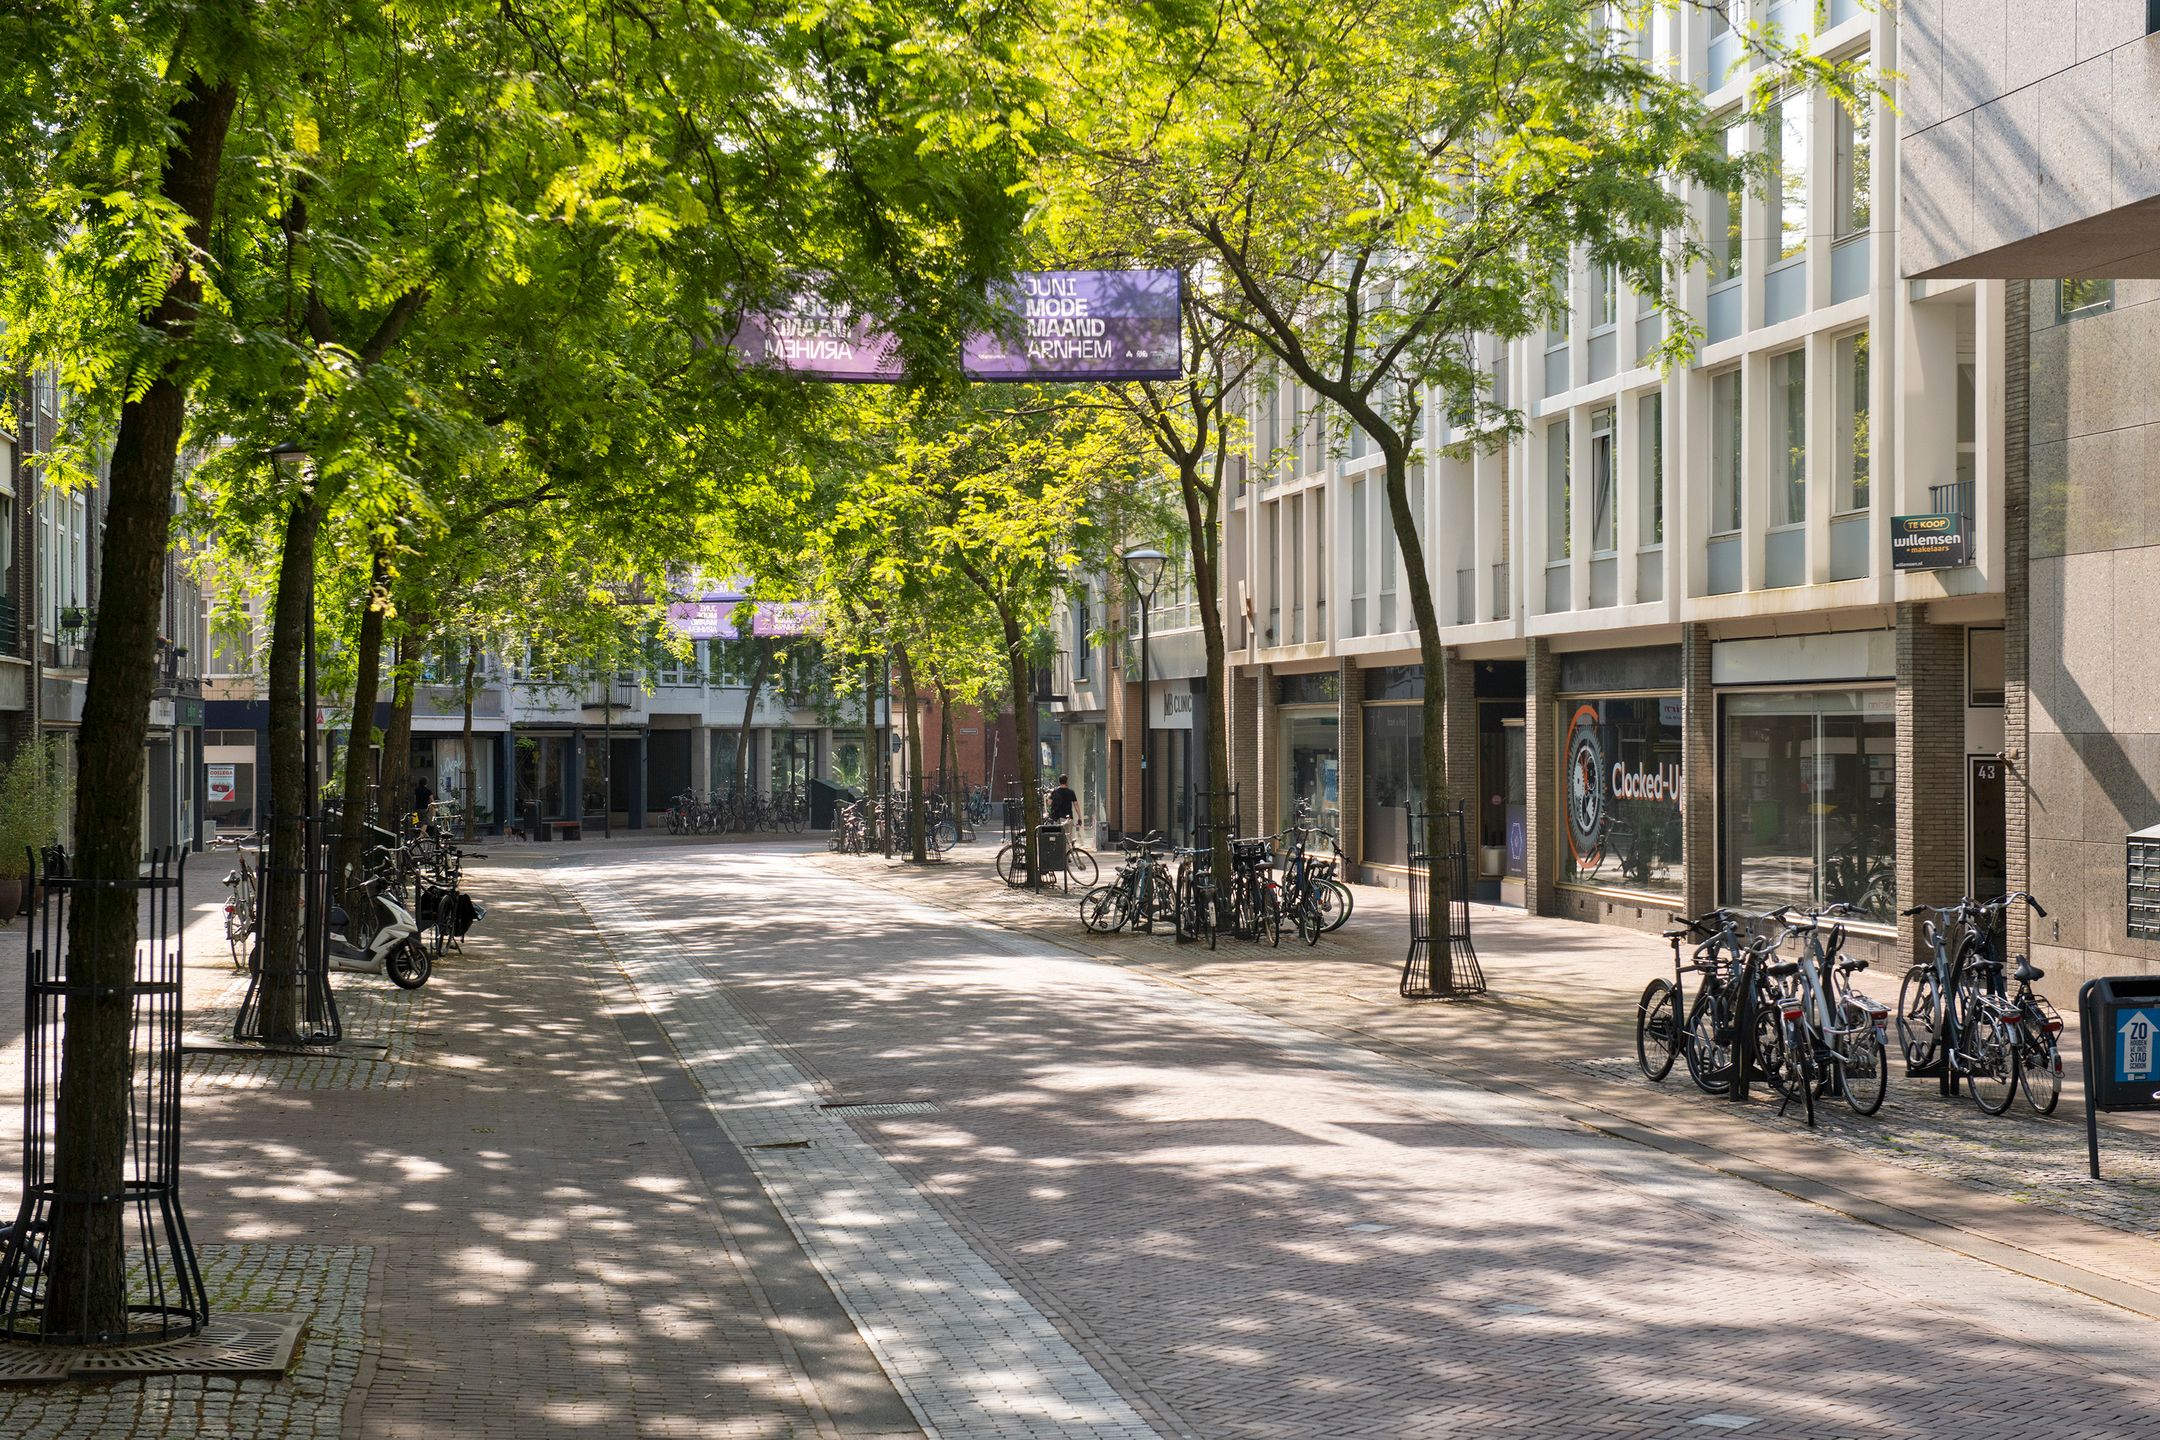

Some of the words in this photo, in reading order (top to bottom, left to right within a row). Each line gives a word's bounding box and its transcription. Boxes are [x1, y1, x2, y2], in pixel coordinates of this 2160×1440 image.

[1025, 278, 1077, 296] JUNI
[1026, 298, 1088, 317] MODE
[1027, 318, 1106, 337] MAAND
[1027, 340, 1112, 359] ARNHEM
[1908, 521, 1918, 529] TE
[1920, 520, 1946, 528] KOOP
[1893, 534, 1962, 547] willemsen
[1911, 545, 1950, 553] makelaars
[1978, 766, 1995, 779] 43
[2131, 1022, 2148, 1039] ZO
[2130, 1053, 2147, 1063] STAD
